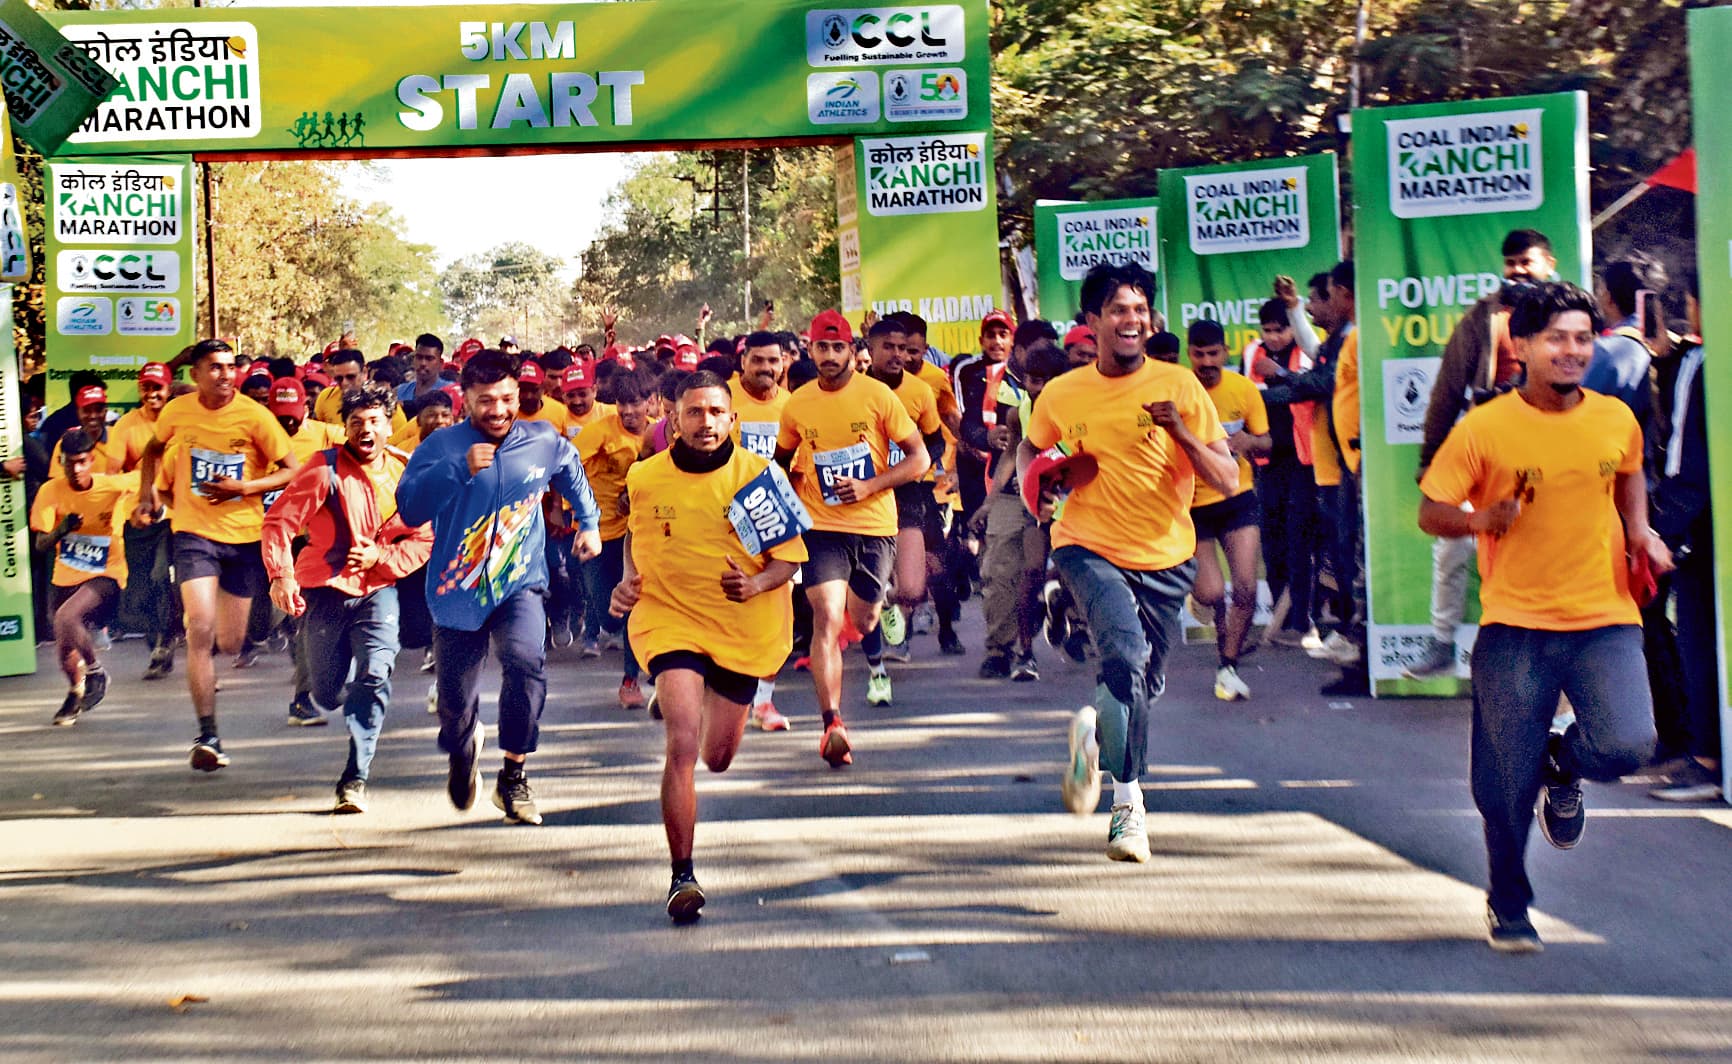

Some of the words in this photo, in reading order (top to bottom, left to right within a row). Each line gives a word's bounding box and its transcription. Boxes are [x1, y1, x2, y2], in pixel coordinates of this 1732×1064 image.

[460, 21, 576, 61] 5KM
[851, 12, 946, 48] CCL
[149, 29, 230, 64] इंडिया
[824, 54, 859, 62] Fuelling
[862, 51, 913, 61] Sustainable
[915, 51, 948, 59] Growth
[396, 71, 645, 131] START
[818, 108, 868, 117] ATHLETICS
[825, 100, 859, 108] INDIAN
[1398, 129, 1454, 149] COAL
[1460, 124, 1519, 144] INDIA
[869, 143, 914, 164] कोल
[917, 140, 968, 163] इंडिया
[60, 169, 106, 190] कोल
[111, 169, 164, 192] इंडिया
[1195, 184, 1239, 199] COAL
[1244, 179, 1290, 195] INDIA
[1399, 173, 1531, 199] MARATHON
[871, 188, 982, 208] MARATHON
[60, 219, 176, 236] MARATHON
[1065, 220, 1101, 233] COAL
[1104, 217, 1142, 230] INDIA
[1197, 218, 1299, 240] MARATHON
[93, 254, 165, 281] CCL
[1066, 250, 1150, 267] MARATHON
[919, 295, 994, 323] KADAM
[1181, 297, 1272, 329] POWE
[1381, 313, 1465, 347] YOU
[822, 458, 865, 487] 6777
